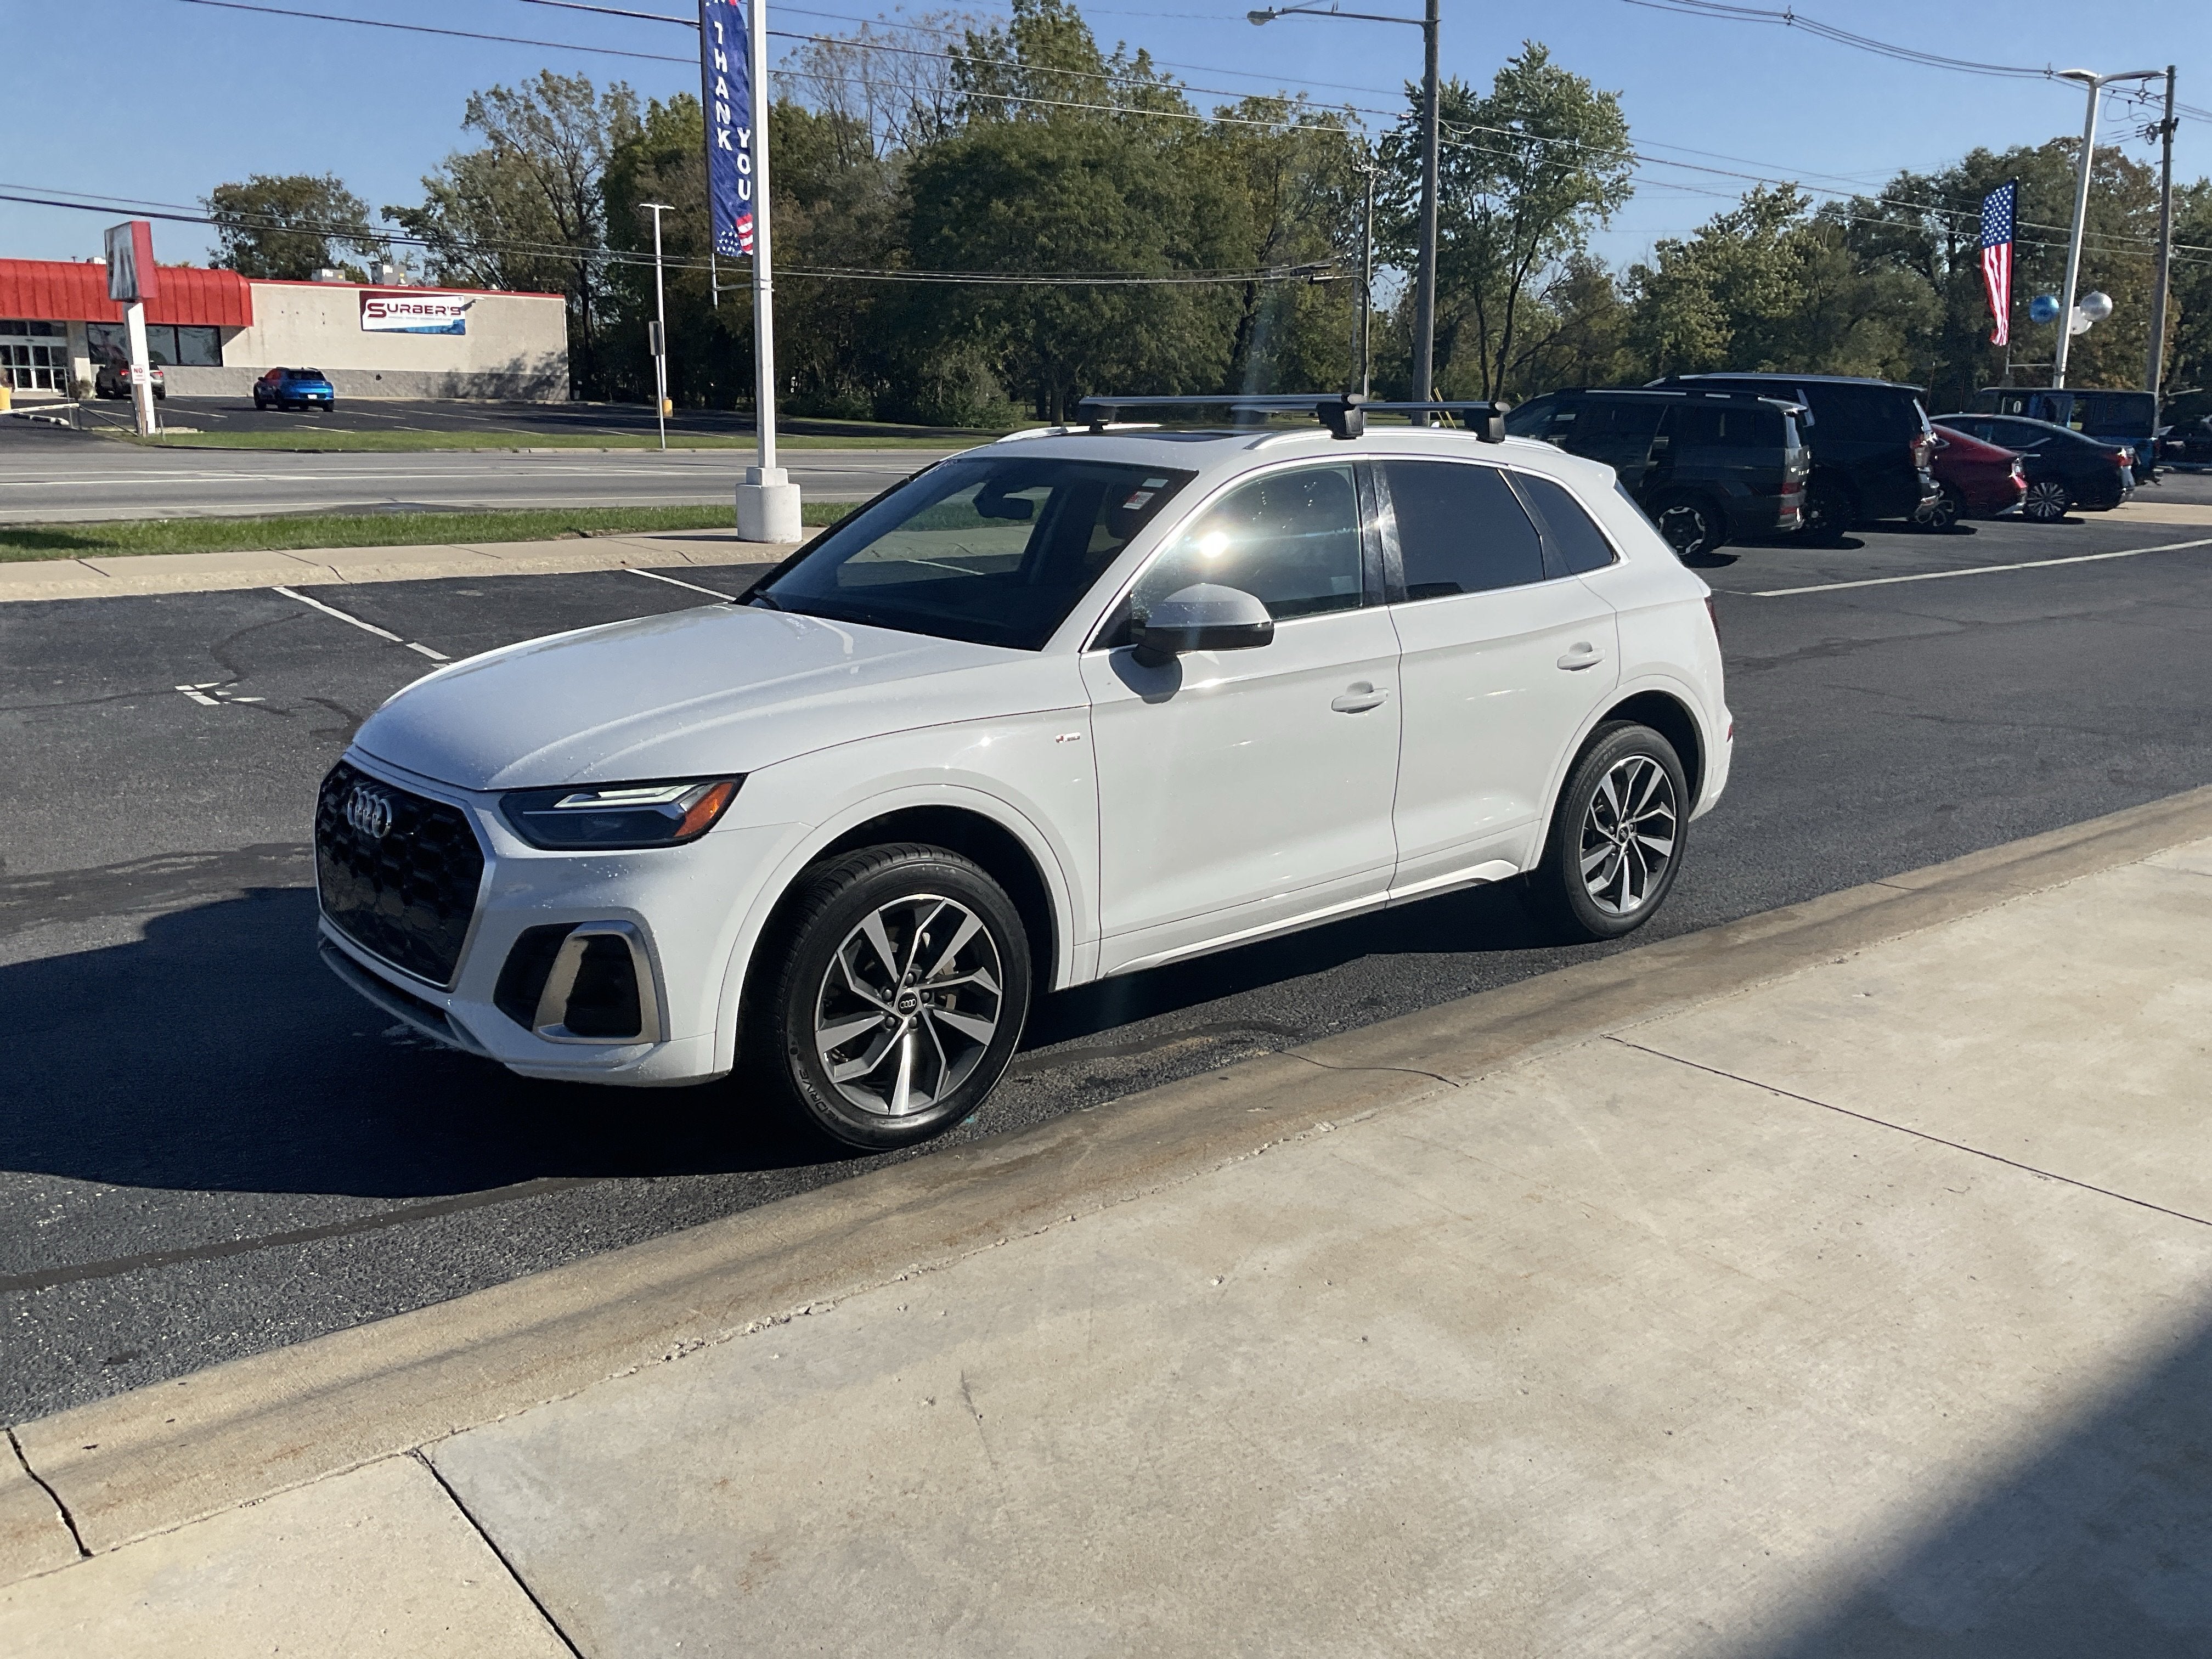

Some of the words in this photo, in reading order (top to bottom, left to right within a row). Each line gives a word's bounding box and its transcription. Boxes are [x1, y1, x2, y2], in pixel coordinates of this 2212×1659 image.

[714, 21, 733, 151] THANK
[737, 127, 751, 201] YOU
[367, 302, 462, 319] SURBER'S
